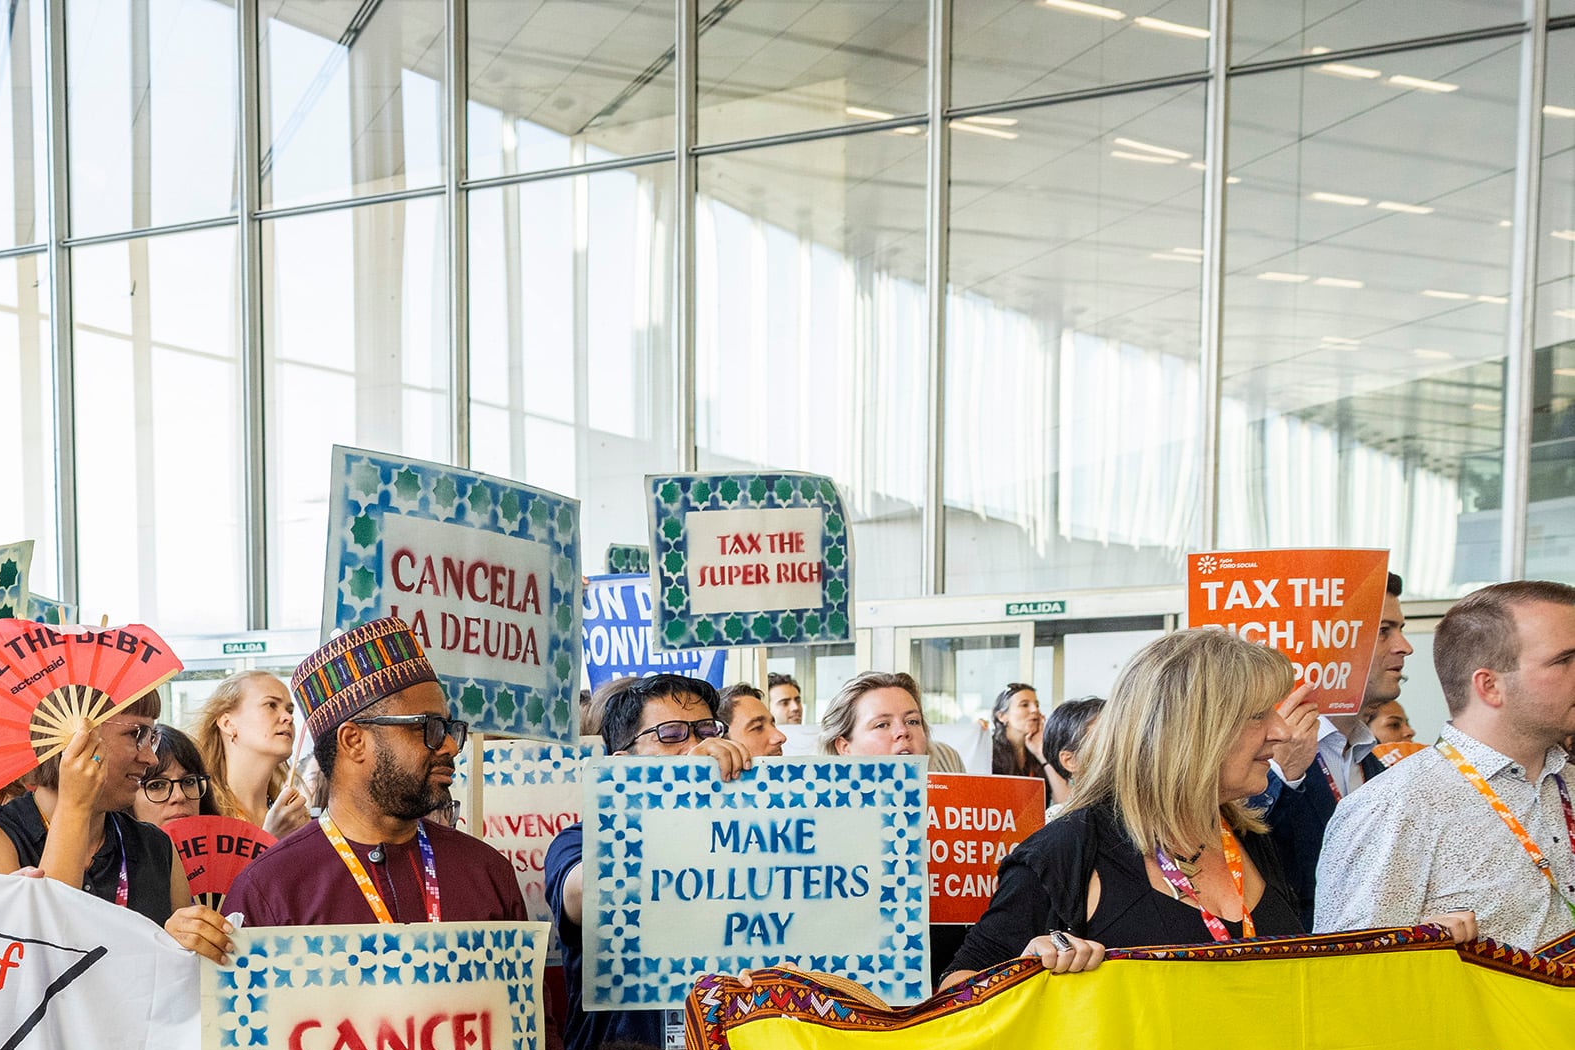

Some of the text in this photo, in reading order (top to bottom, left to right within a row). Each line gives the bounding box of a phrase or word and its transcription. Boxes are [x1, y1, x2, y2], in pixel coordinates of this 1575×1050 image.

[716, 531, 806, 555] TAX THE
[390, 547, 543, 616] CANCELA
[696, 560, 823, 588] SUPER RICH
[1008, 602, 1063, 615] SALIDA
[1200, 577, 1345, 611] TAX THE
[4, 627, 67, 660] THE
[225, 642, 264, 653] SALIDA
[440, 611, 542, 666] DEUDA
[1311, 619, 1363, 650] NOT
[944, 806, 1017, 833] DEUDA
[178, 835, 209, 862] HE
[710, 817, 818, 855] MAKE
[953, 840, 978, 865] SE
[649, 864, 871, 902] POLLUTERS
[722, 911, 796, 947] PAY
